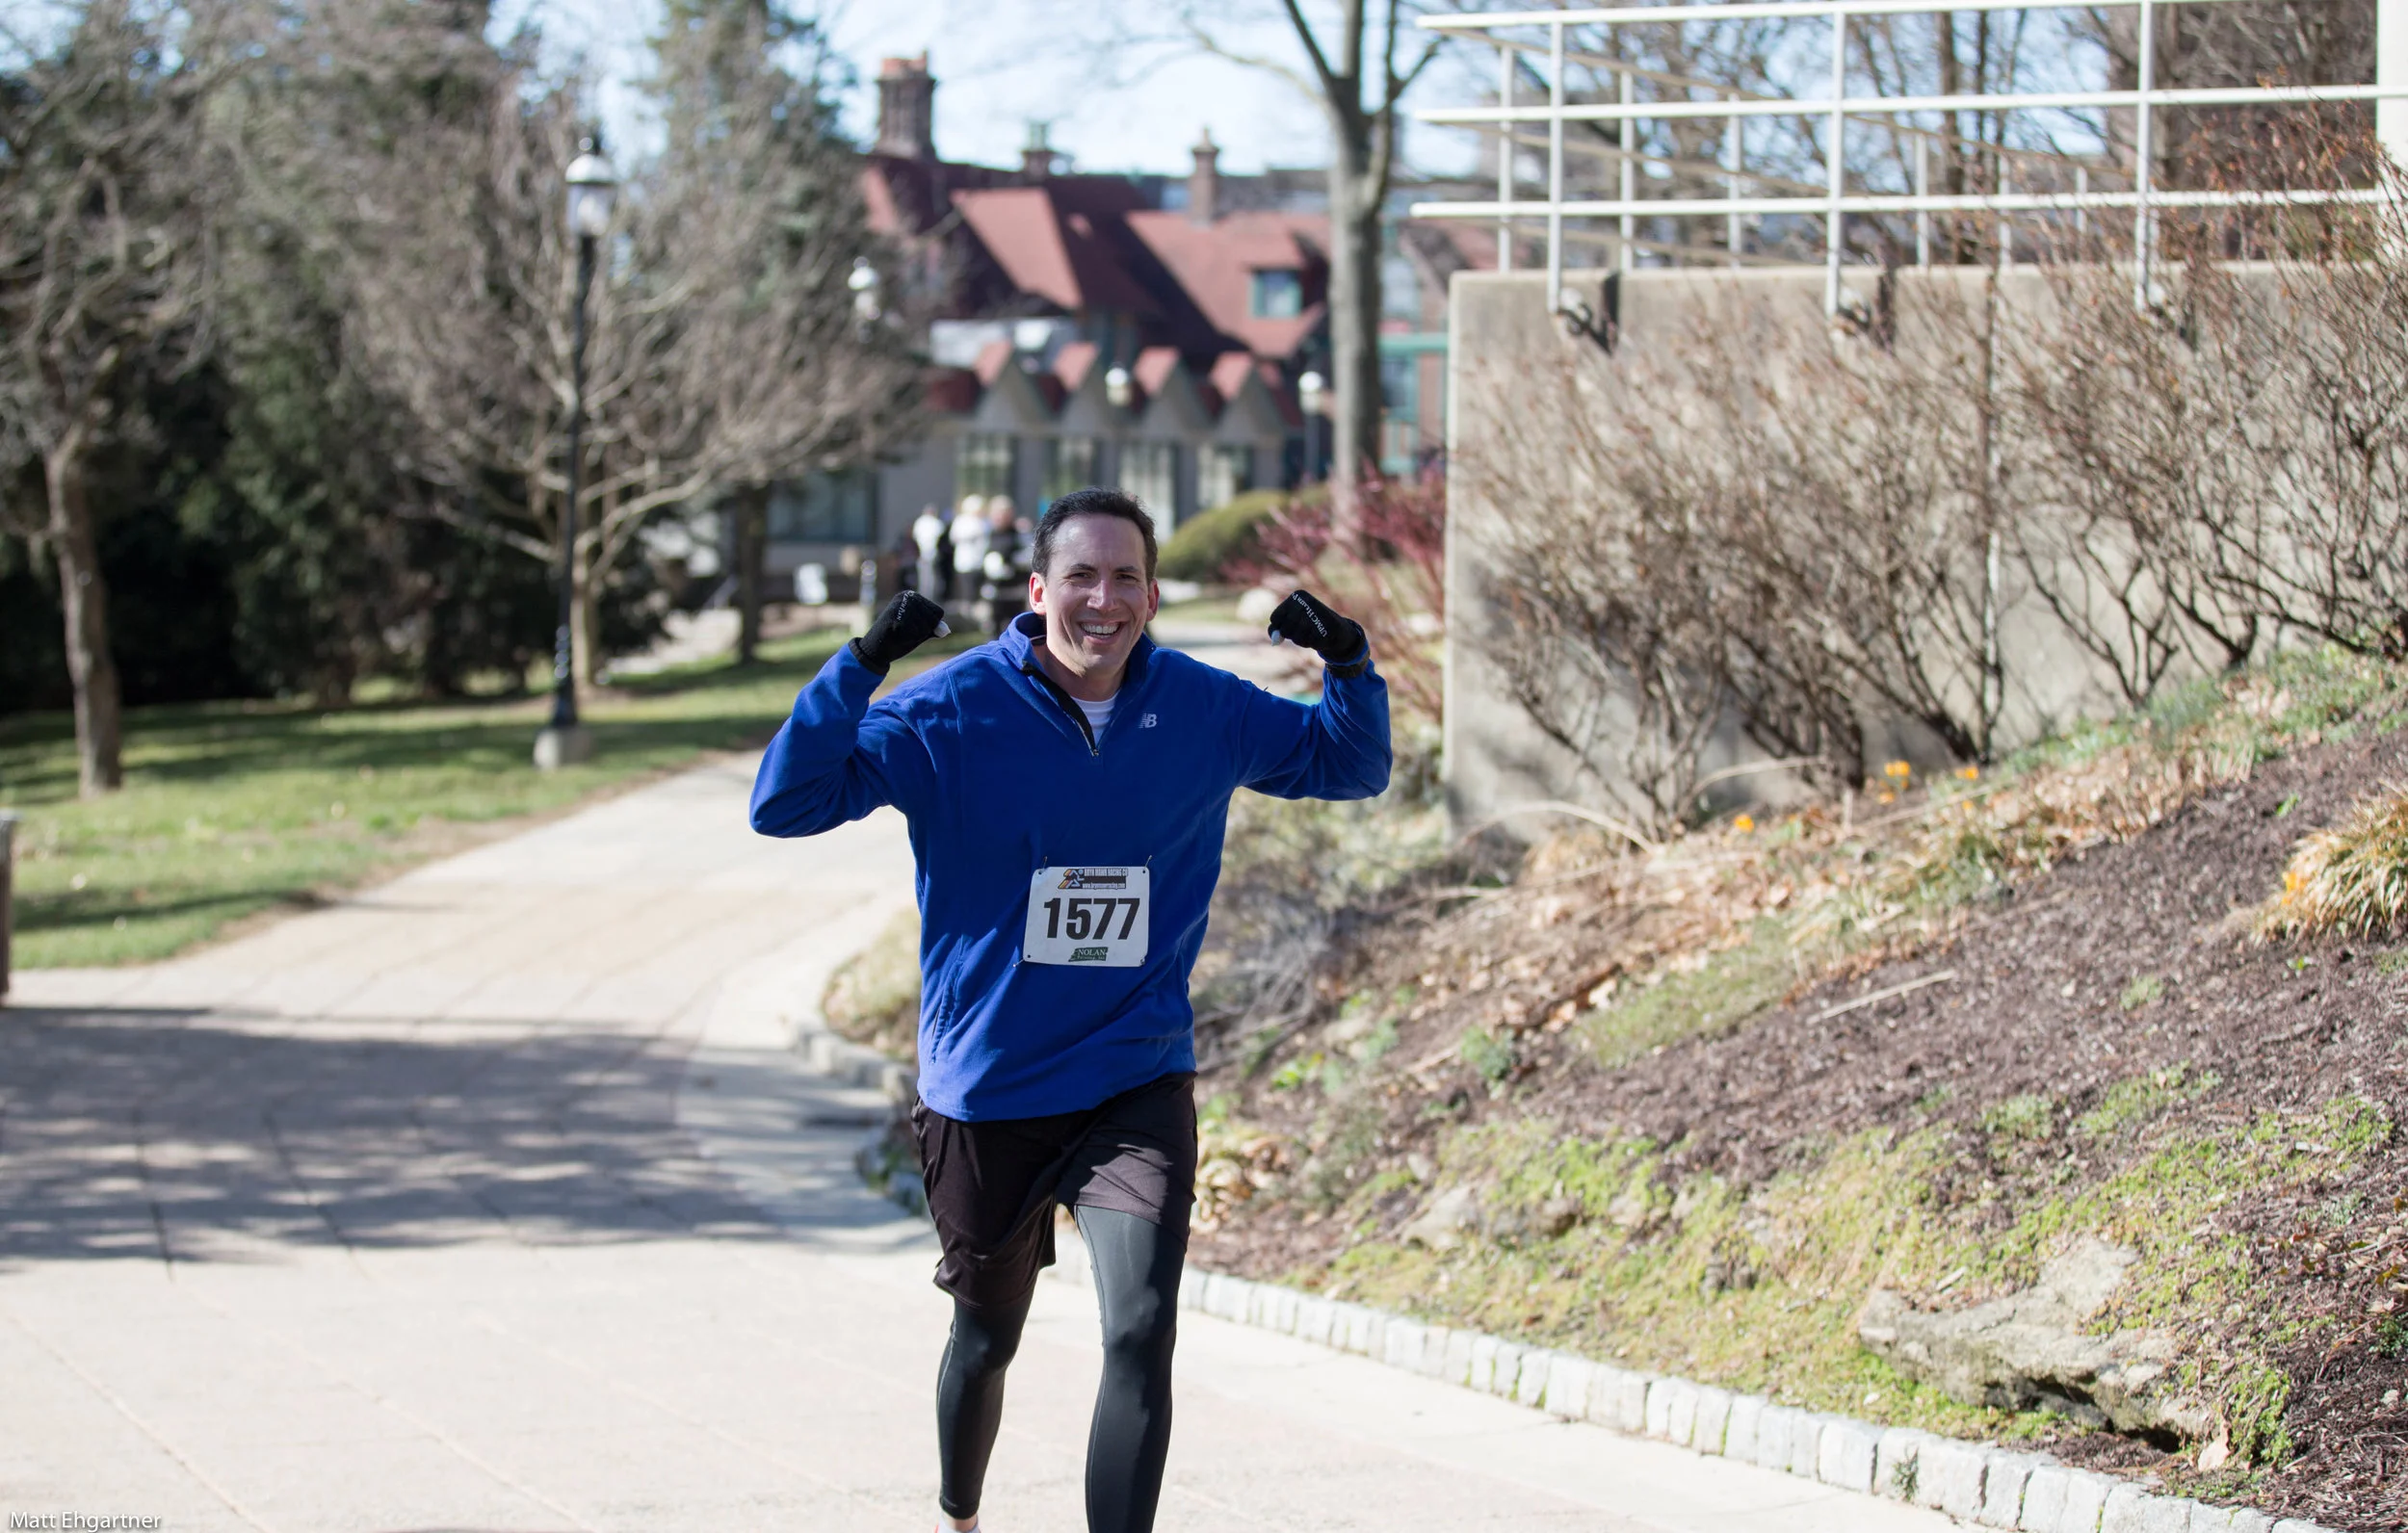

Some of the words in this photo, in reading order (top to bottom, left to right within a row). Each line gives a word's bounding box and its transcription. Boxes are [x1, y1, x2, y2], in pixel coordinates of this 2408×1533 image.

[1311, 615, 1327, 637] UPMC
[1043, 897, 1140, 940] 1577
[1078, 948, 1107, 956] NOLAN
